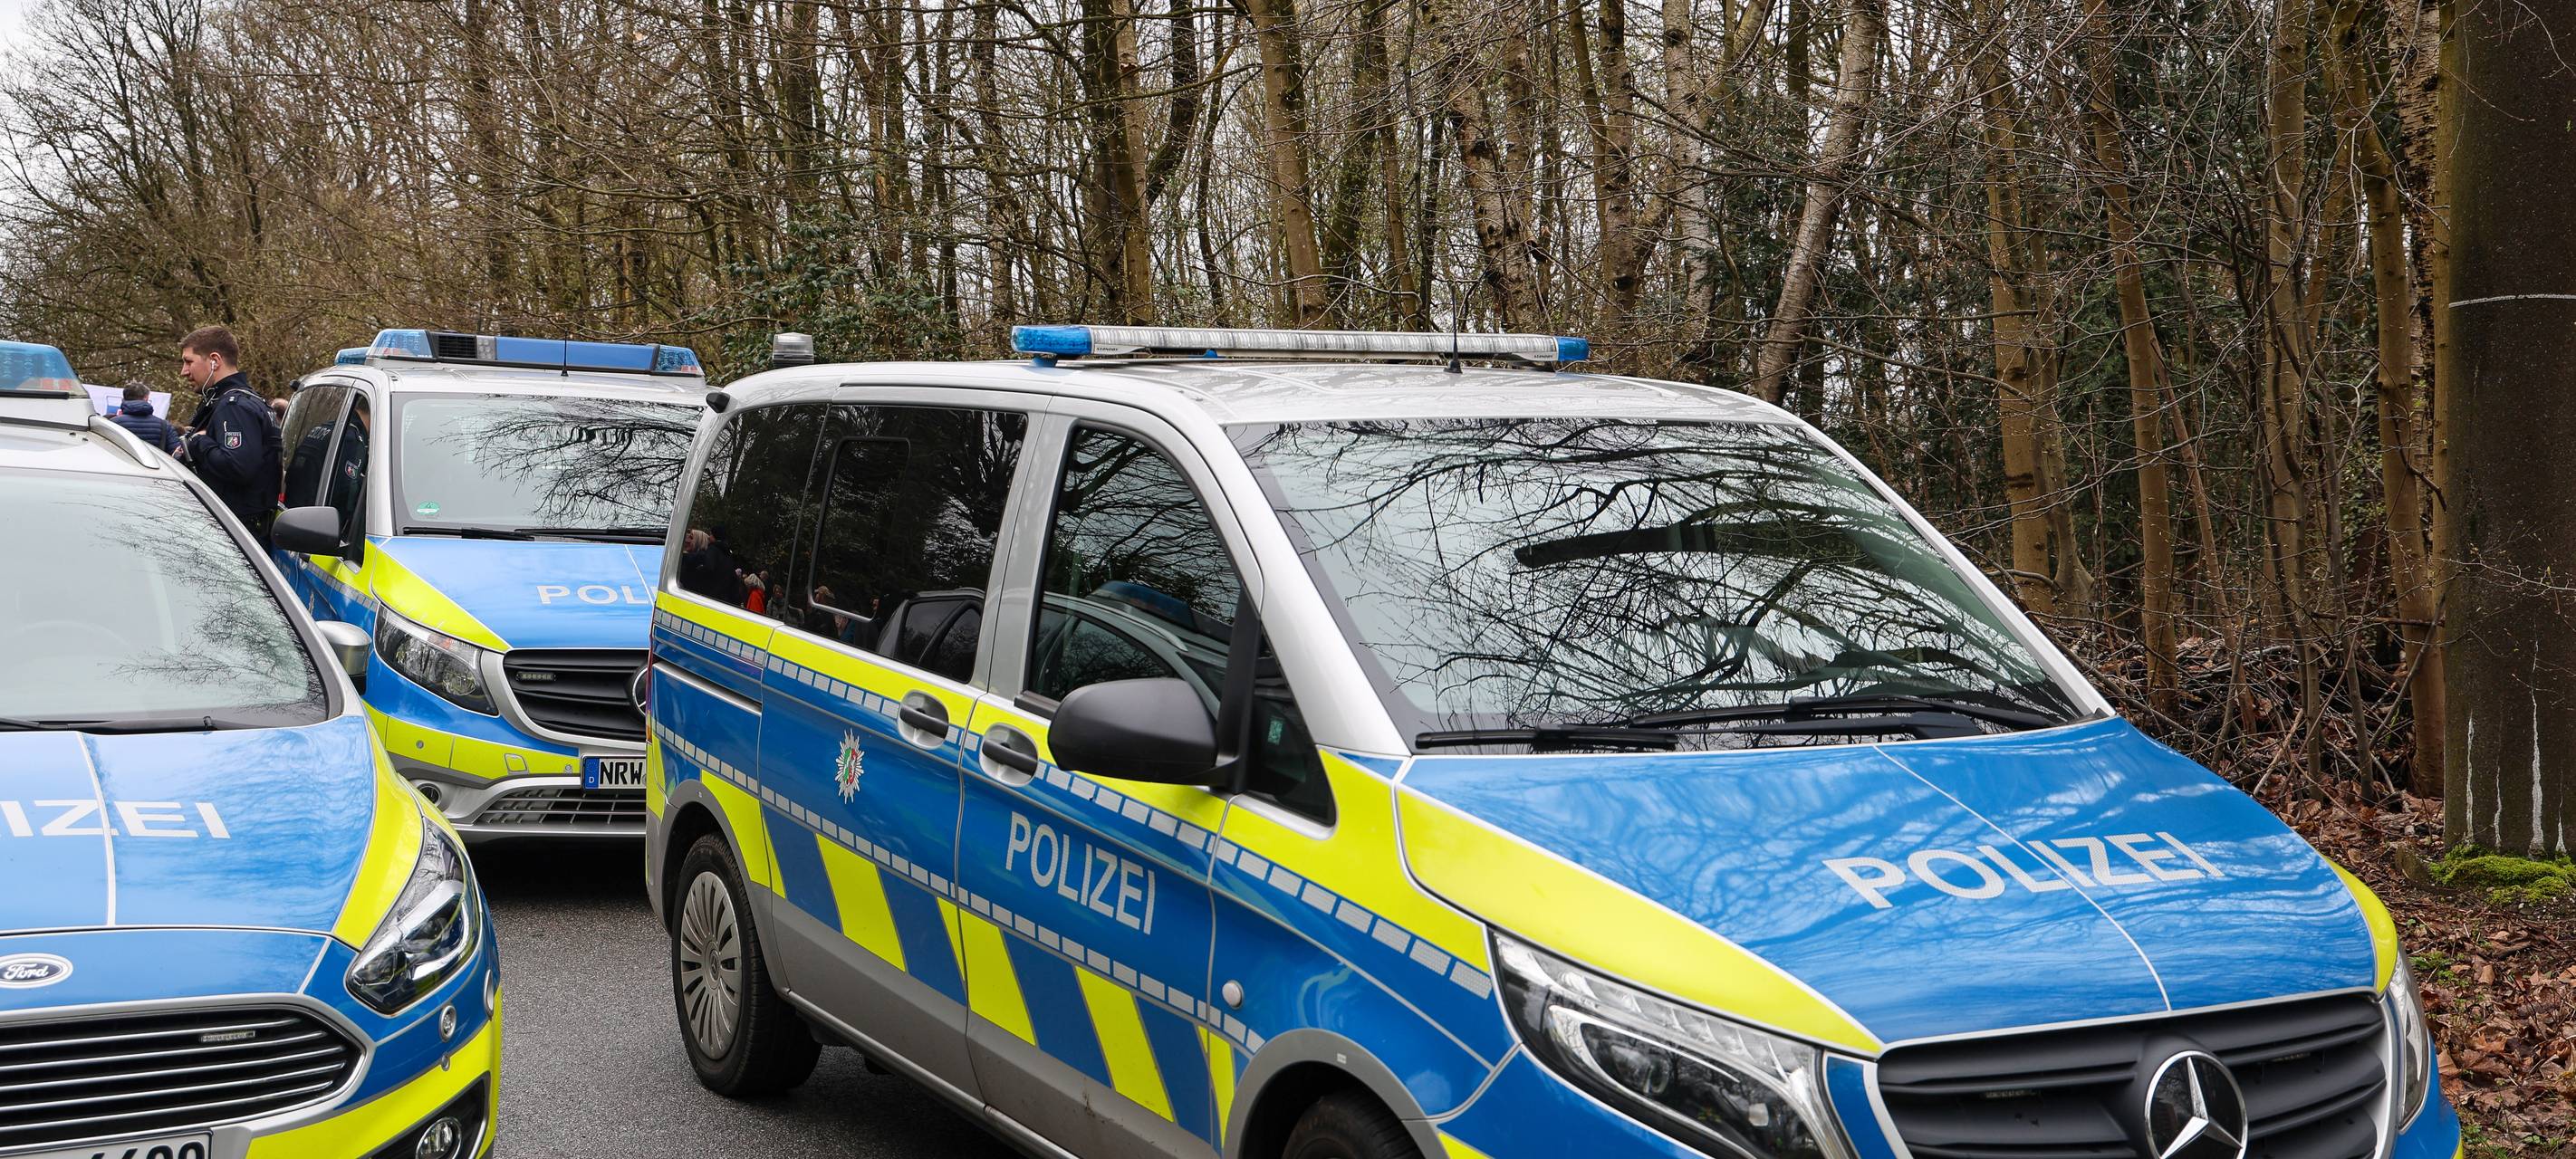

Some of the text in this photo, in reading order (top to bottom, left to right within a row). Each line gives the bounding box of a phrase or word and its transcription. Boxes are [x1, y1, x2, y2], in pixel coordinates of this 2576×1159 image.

[600, 761, 643, 785] NRW
[1005, 810, 1156, 935] POLIZEI
[1821, 831, 2225, 909] POLIZEI
[4, 963, 49, 980] Ford
